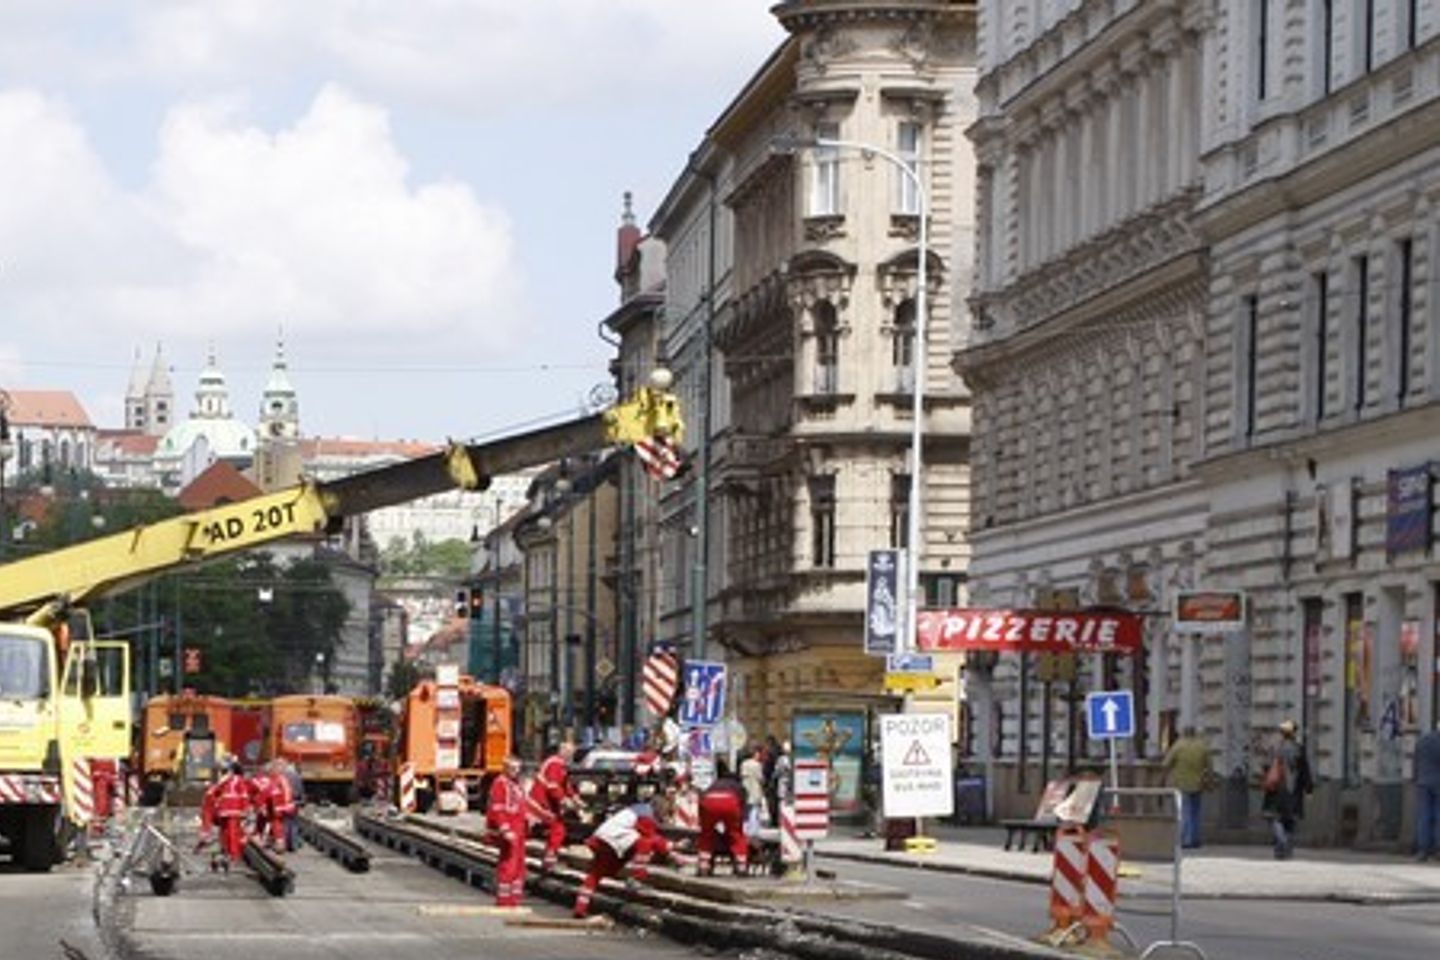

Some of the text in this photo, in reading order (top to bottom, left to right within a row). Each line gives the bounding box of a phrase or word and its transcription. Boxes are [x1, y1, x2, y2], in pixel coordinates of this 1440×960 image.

[210, 501, 297, 545] AD 20T
[943, 615, 1120, 644] PIZZERIE
[886, 717, 946, 737] POZOR
